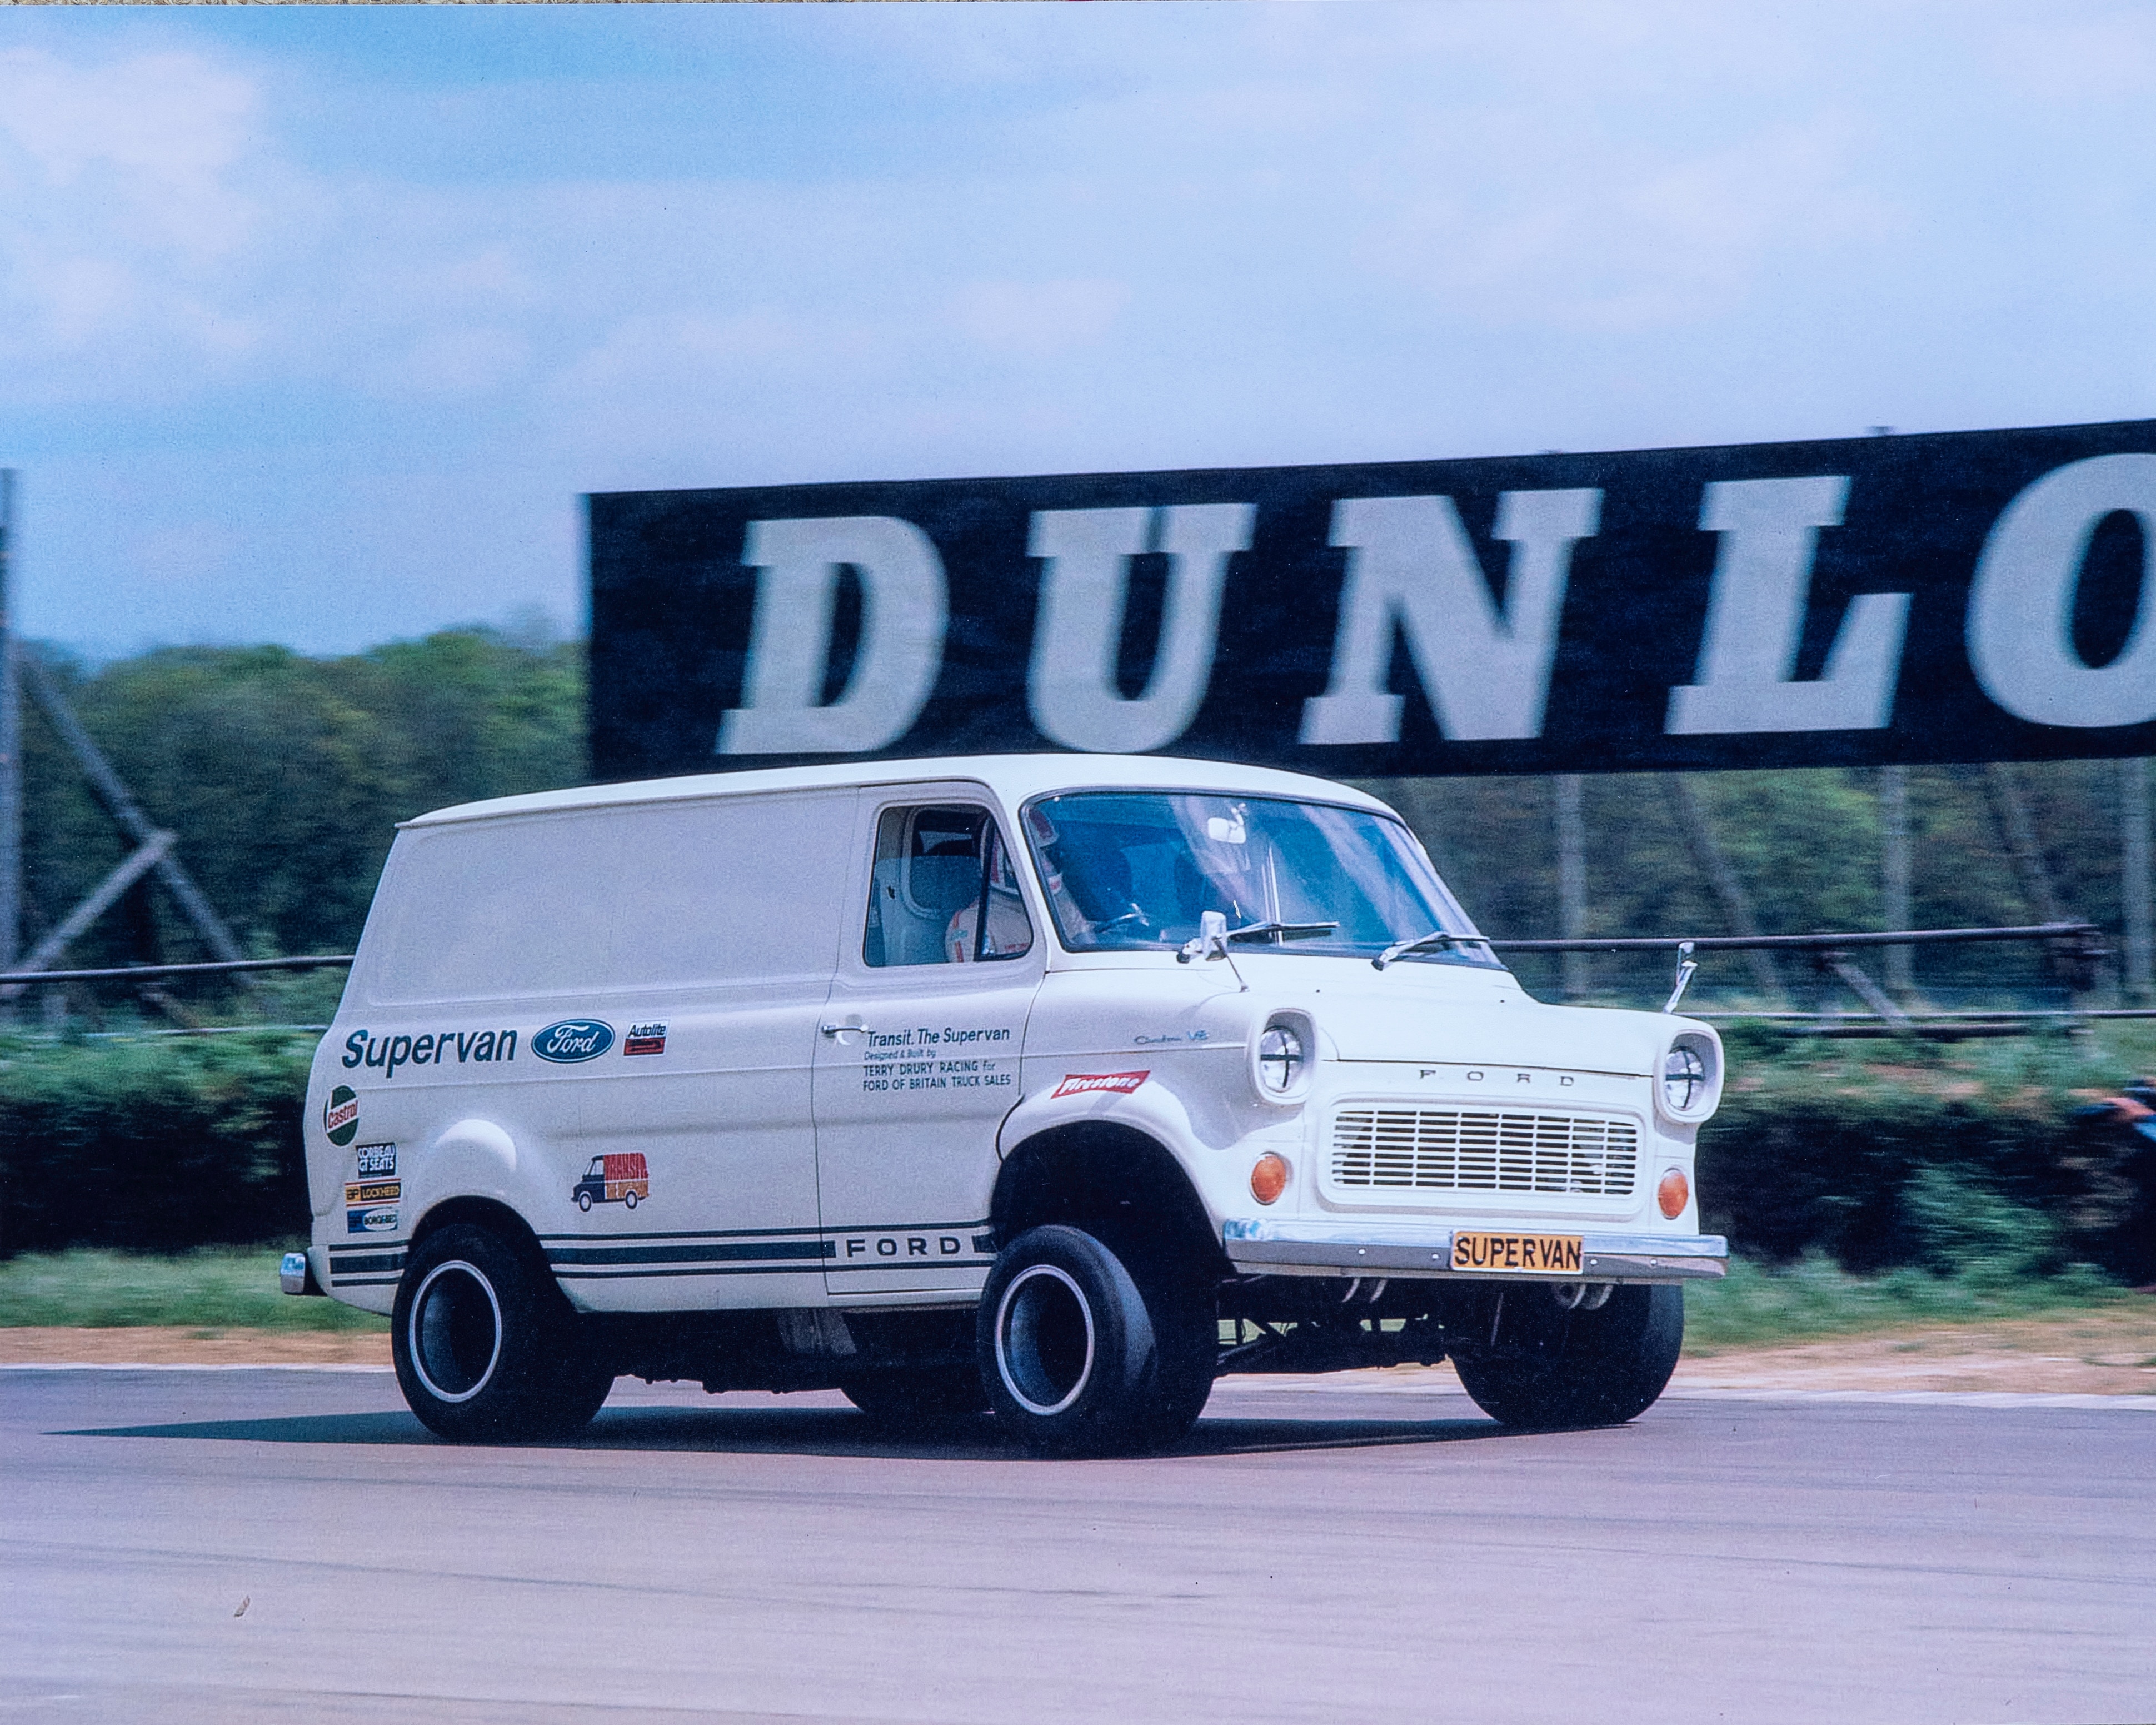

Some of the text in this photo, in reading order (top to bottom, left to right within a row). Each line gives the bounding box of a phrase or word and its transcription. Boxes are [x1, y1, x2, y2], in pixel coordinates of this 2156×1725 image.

[717, 452, 2156, 756] DUNLO
[547, 1025, 598, 1053] Ford
[627, 1024, 666, 1038] Autolite
[868, 1028, 1010, 1047] Transit. The Supervan
[342, 1029, 518, 1079] Supervan
[927, 1049, 936, 1058] by
[863, 1064, 894, 1076] TERRY
[899, 1062, 934, 1075] DRURY
[939, 1060, 979, 1073] RACING
[863, 1074, 1011, 1091] FORD OF BRITAIN TRUCK SALES
[1058, 1076, 1140, 1095] Firestone
[1420, 1069, 1574, 1086] FORD
[328, 1100, 358, 1129] Castrol
[357, 1144, 395, 1159] CORBEAU
[358, 1157, 395, 1172] GT SEATS
[846, 1237, 960, 1257] FORD
